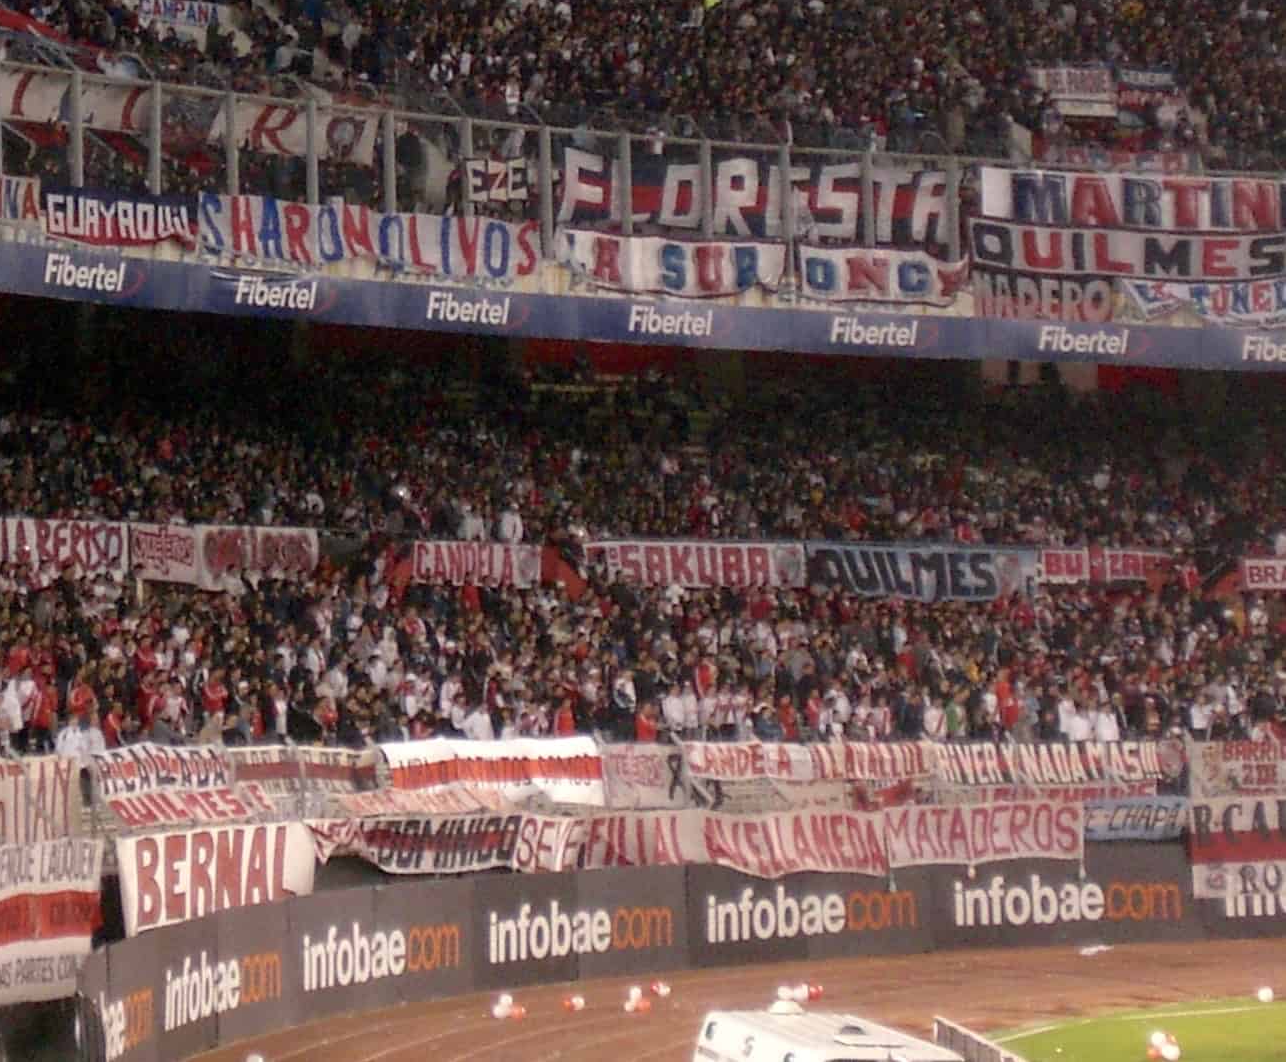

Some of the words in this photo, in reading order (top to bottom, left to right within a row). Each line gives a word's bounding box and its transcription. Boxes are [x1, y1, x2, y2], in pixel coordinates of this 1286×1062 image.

[466, 156, 527, 202] EZE
[1014, 172, 1286, 230] MARTIN
[557, 146, 950, 264] FLORESTA
[45, 253, 125, 292] Fibertel
[972, 222, 1286, 279] QUILMES
[234, 275, 317, 311] Fibertel
[426, 291, 510, 325] Fibertel
[971, 271, 1113, 324] MADERO
[628, 304, 713, 337] Fibertel
[830, 316, 918, 348] Fibertel
[1038, 325, 1129, 355] Fibertel
[617, 544, 772, 588] SAKURA
[814, 548, 1000, 598] QUILMES
[1017, 740, 1089, 785] NADA
[109, 788, 247, 827] QUILMES
[704, 814, 889, 876] AVELLANEDA
[885, 802, 1080, 861] MATADEROS
[135, 825, 295, 927] BERNAL
